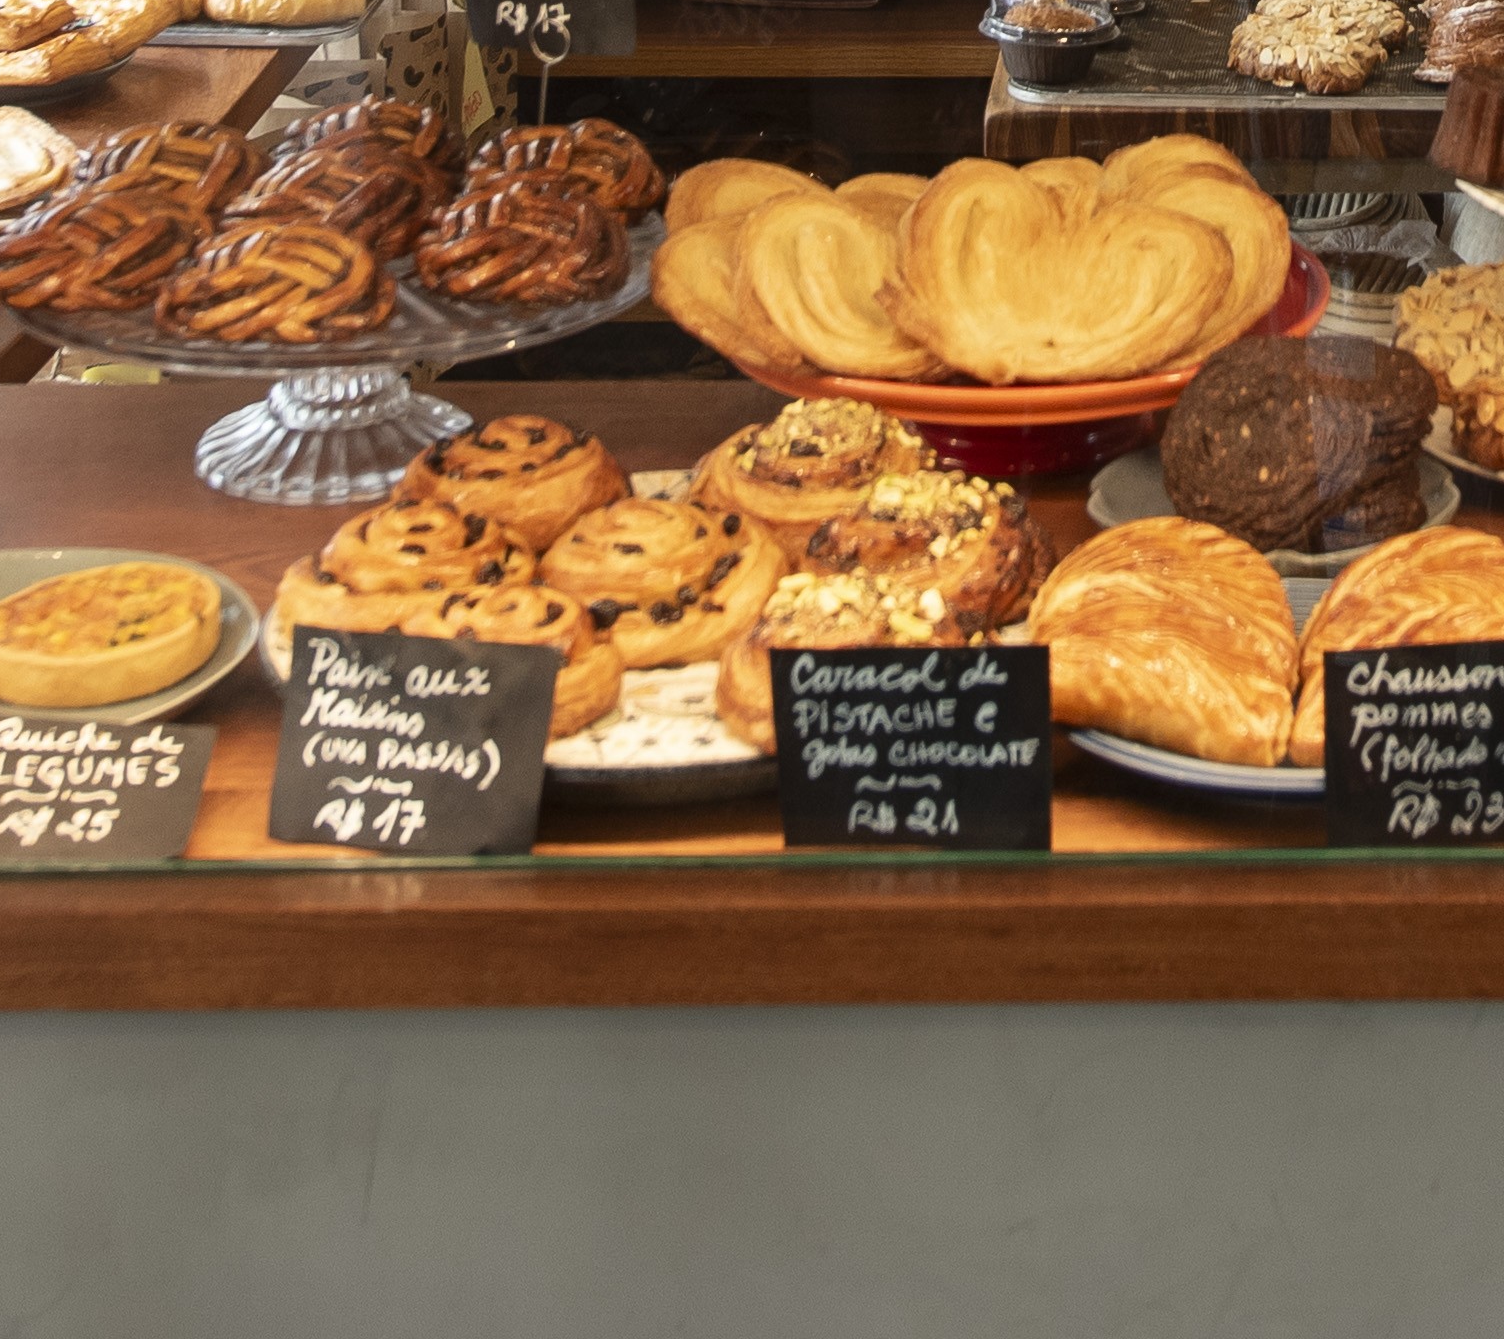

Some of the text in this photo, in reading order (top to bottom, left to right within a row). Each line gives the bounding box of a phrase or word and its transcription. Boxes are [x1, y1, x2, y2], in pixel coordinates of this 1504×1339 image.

[496, 0, 571, 35] R$ 17
[307, 637, 491, 698] Pain aux
[790, 651, 1008, 694] Caracol de
[792, 698, 957, 738] PISTACHE
[1350, 701, 1493, 748] pommes
[130, 725, 184, 755] de
[888, 738, 1040, 768] CHOCOLATE
[54, 807, 121, 842] 25
[312, 797, 427, 845] R$ 17
[848, 797, 959, 836] R$ 21
[1387, 793, 1441, 839] R$
